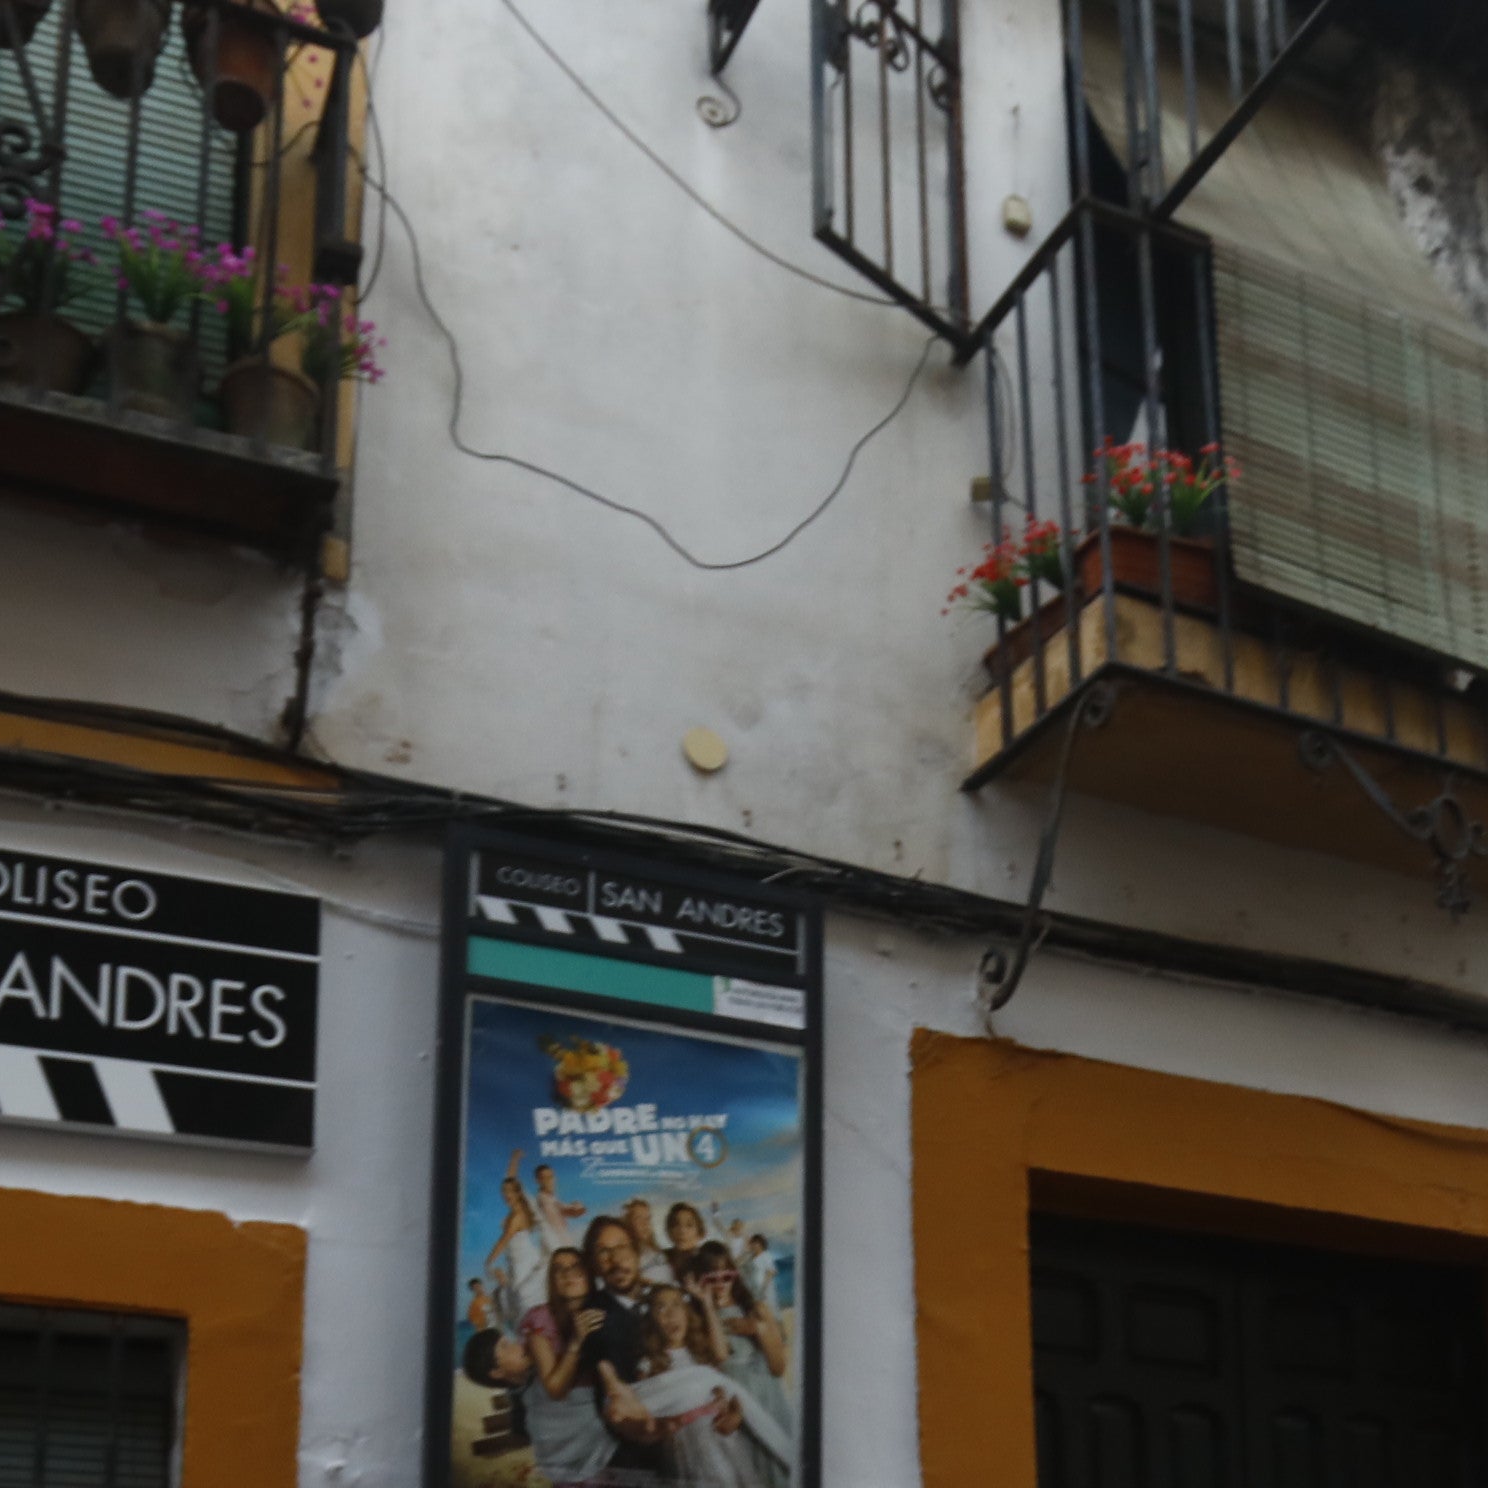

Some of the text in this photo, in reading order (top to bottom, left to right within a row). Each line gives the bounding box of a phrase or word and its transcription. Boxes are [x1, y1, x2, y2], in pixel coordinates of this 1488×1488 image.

[496, 866, 785, 938] COLISEO SAN ANDRES
[533, 1103, 659, 1136] PADRE
[631, 1132, 690, 1165] UN
[696, 1133, 715, 1160] 4
